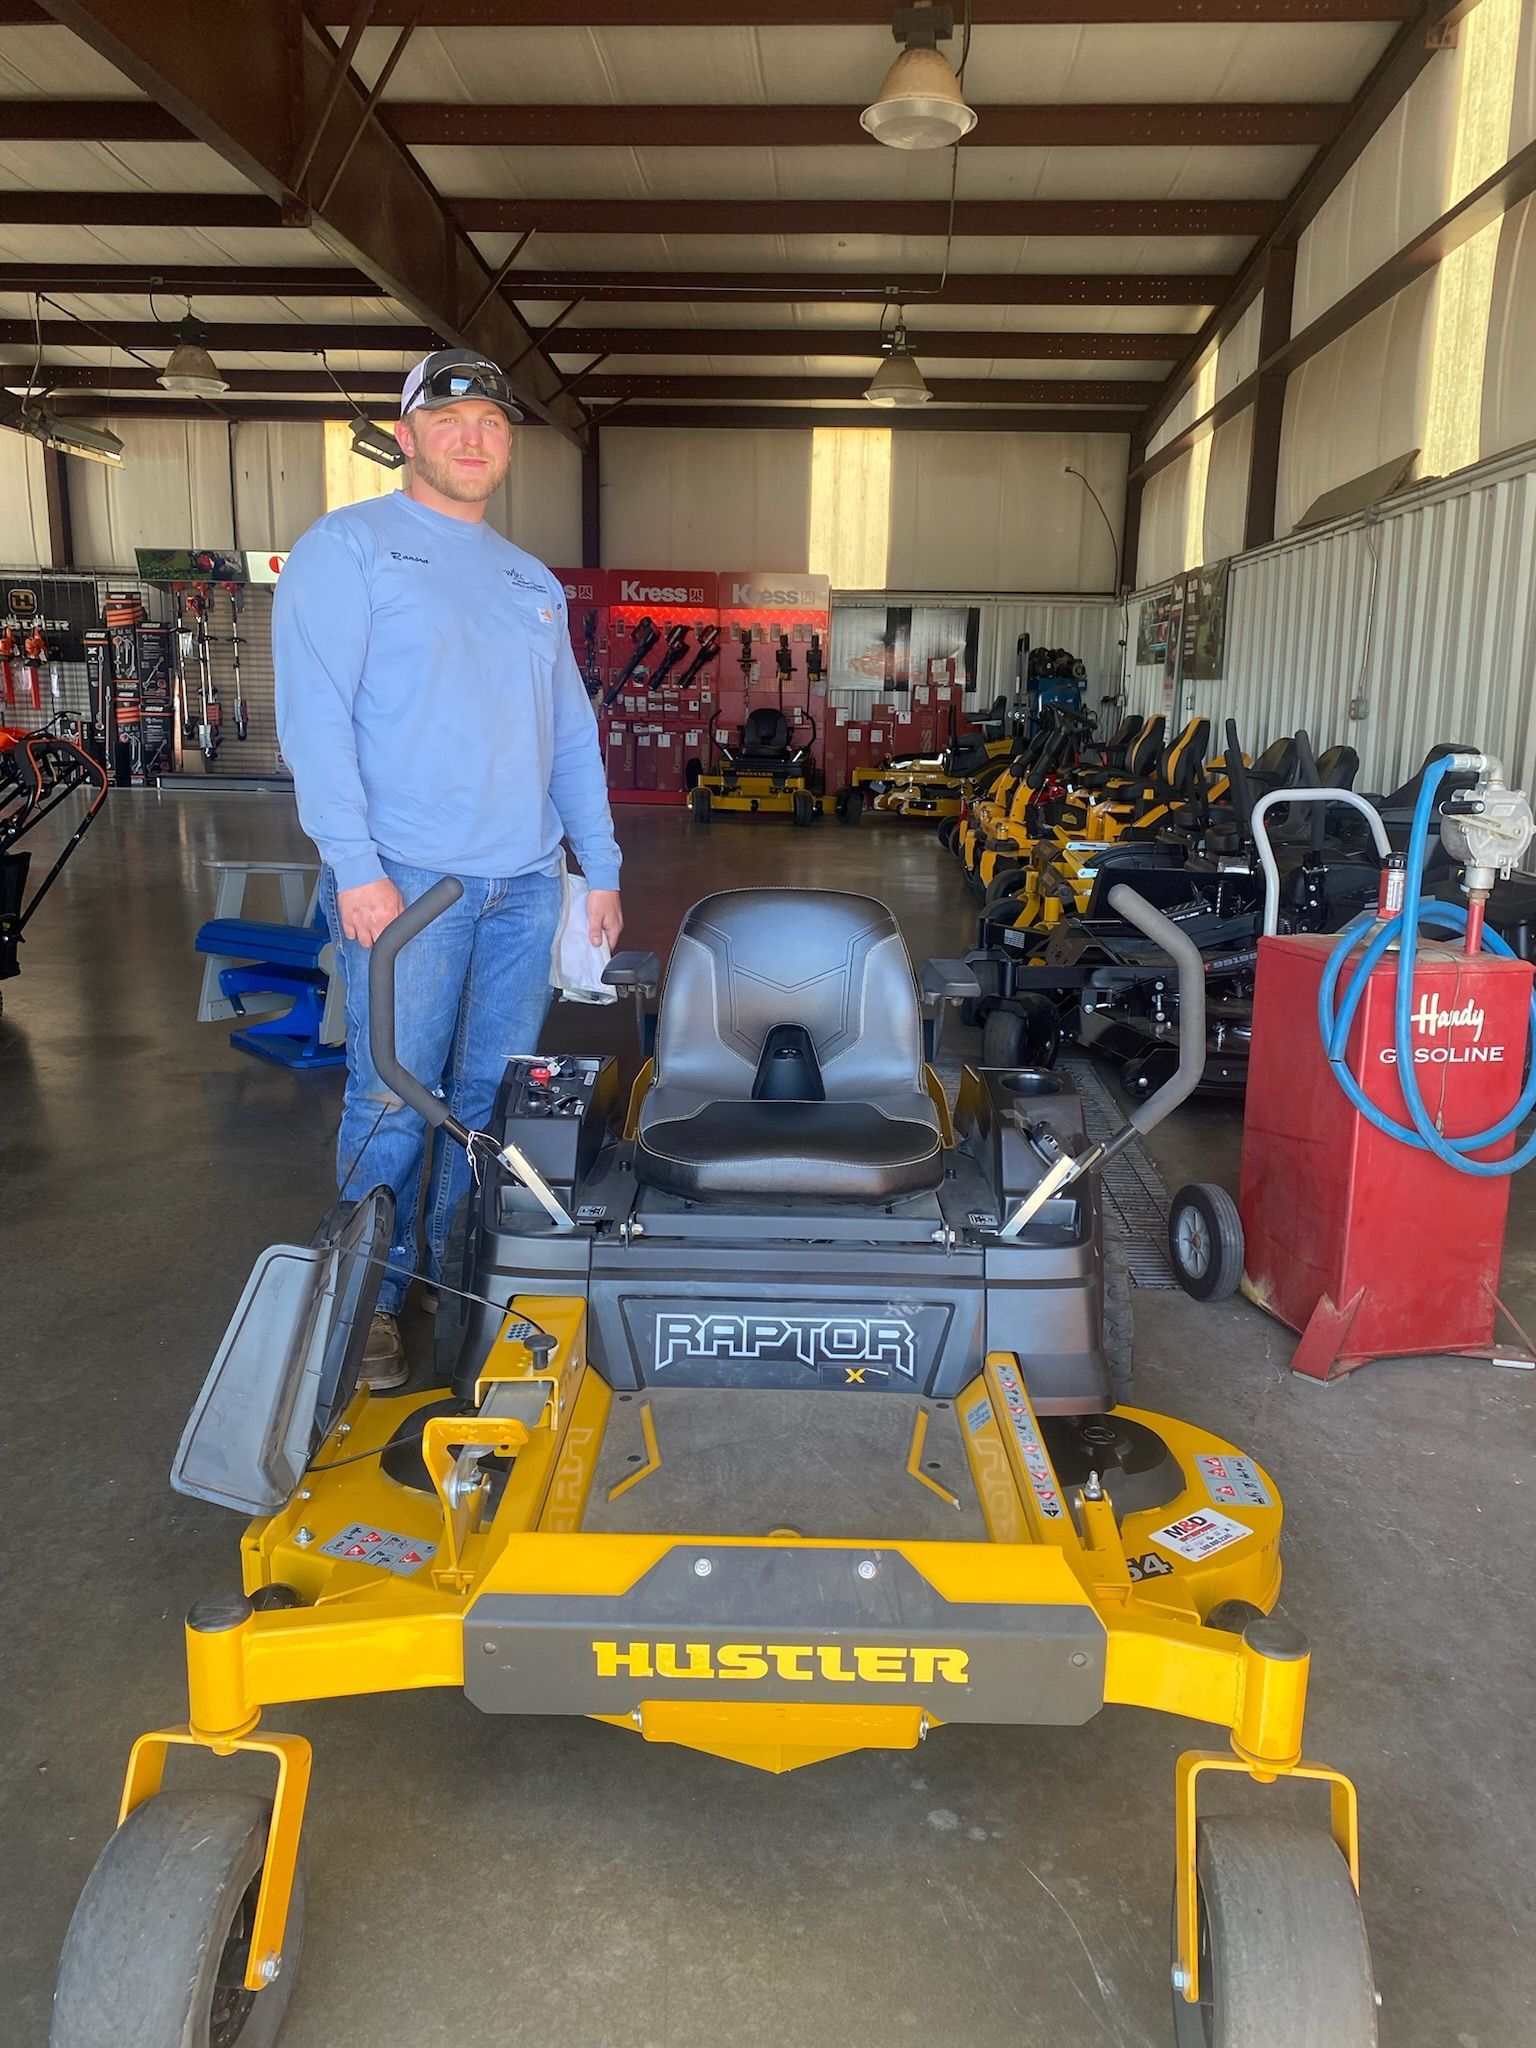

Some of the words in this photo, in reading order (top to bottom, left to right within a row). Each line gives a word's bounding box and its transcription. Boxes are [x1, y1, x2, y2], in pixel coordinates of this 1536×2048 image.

[621, 580, 688, 602] Kress
[732, 583, 802, 605] Kress
[1411, 992, 1484, 1042] Handy
[1380, 1046, 1504, 1064] GSOLINE
[654, 1312, 916, 1378] RAPTOR
[845, 1367, 866, 1384] X
[1163, 1516, 1208, 1539] M&D
[592, 1641, 969, 1684] HUSTLER
